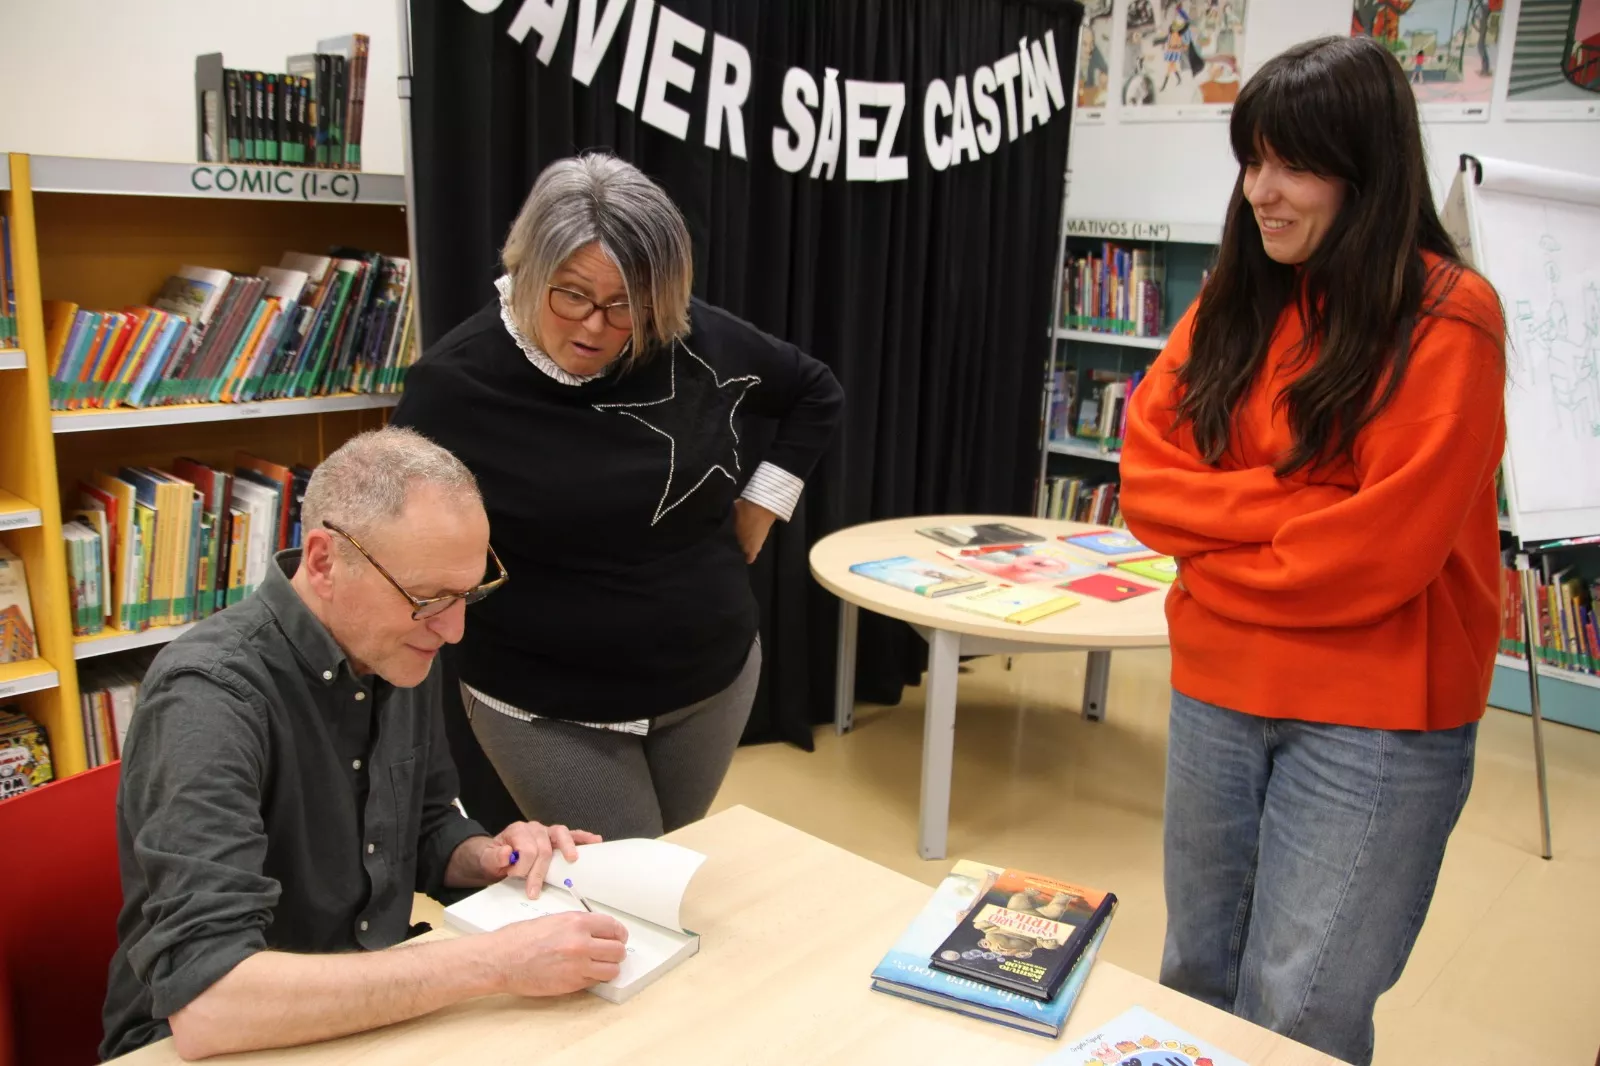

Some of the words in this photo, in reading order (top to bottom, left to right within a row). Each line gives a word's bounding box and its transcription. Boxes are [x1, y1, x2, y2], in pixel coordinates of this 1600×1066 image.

[462, 0, 752, 161] AVIER
[772, 66, 909, 182] SÁEZ
[923, 29, 1065, 171] CASTÁN
[301, 172, 360, 202] (I-C)
[996, 908, 1059, 935] VERTICAL
[998, 964, 1043, 980] INSTITUTO
